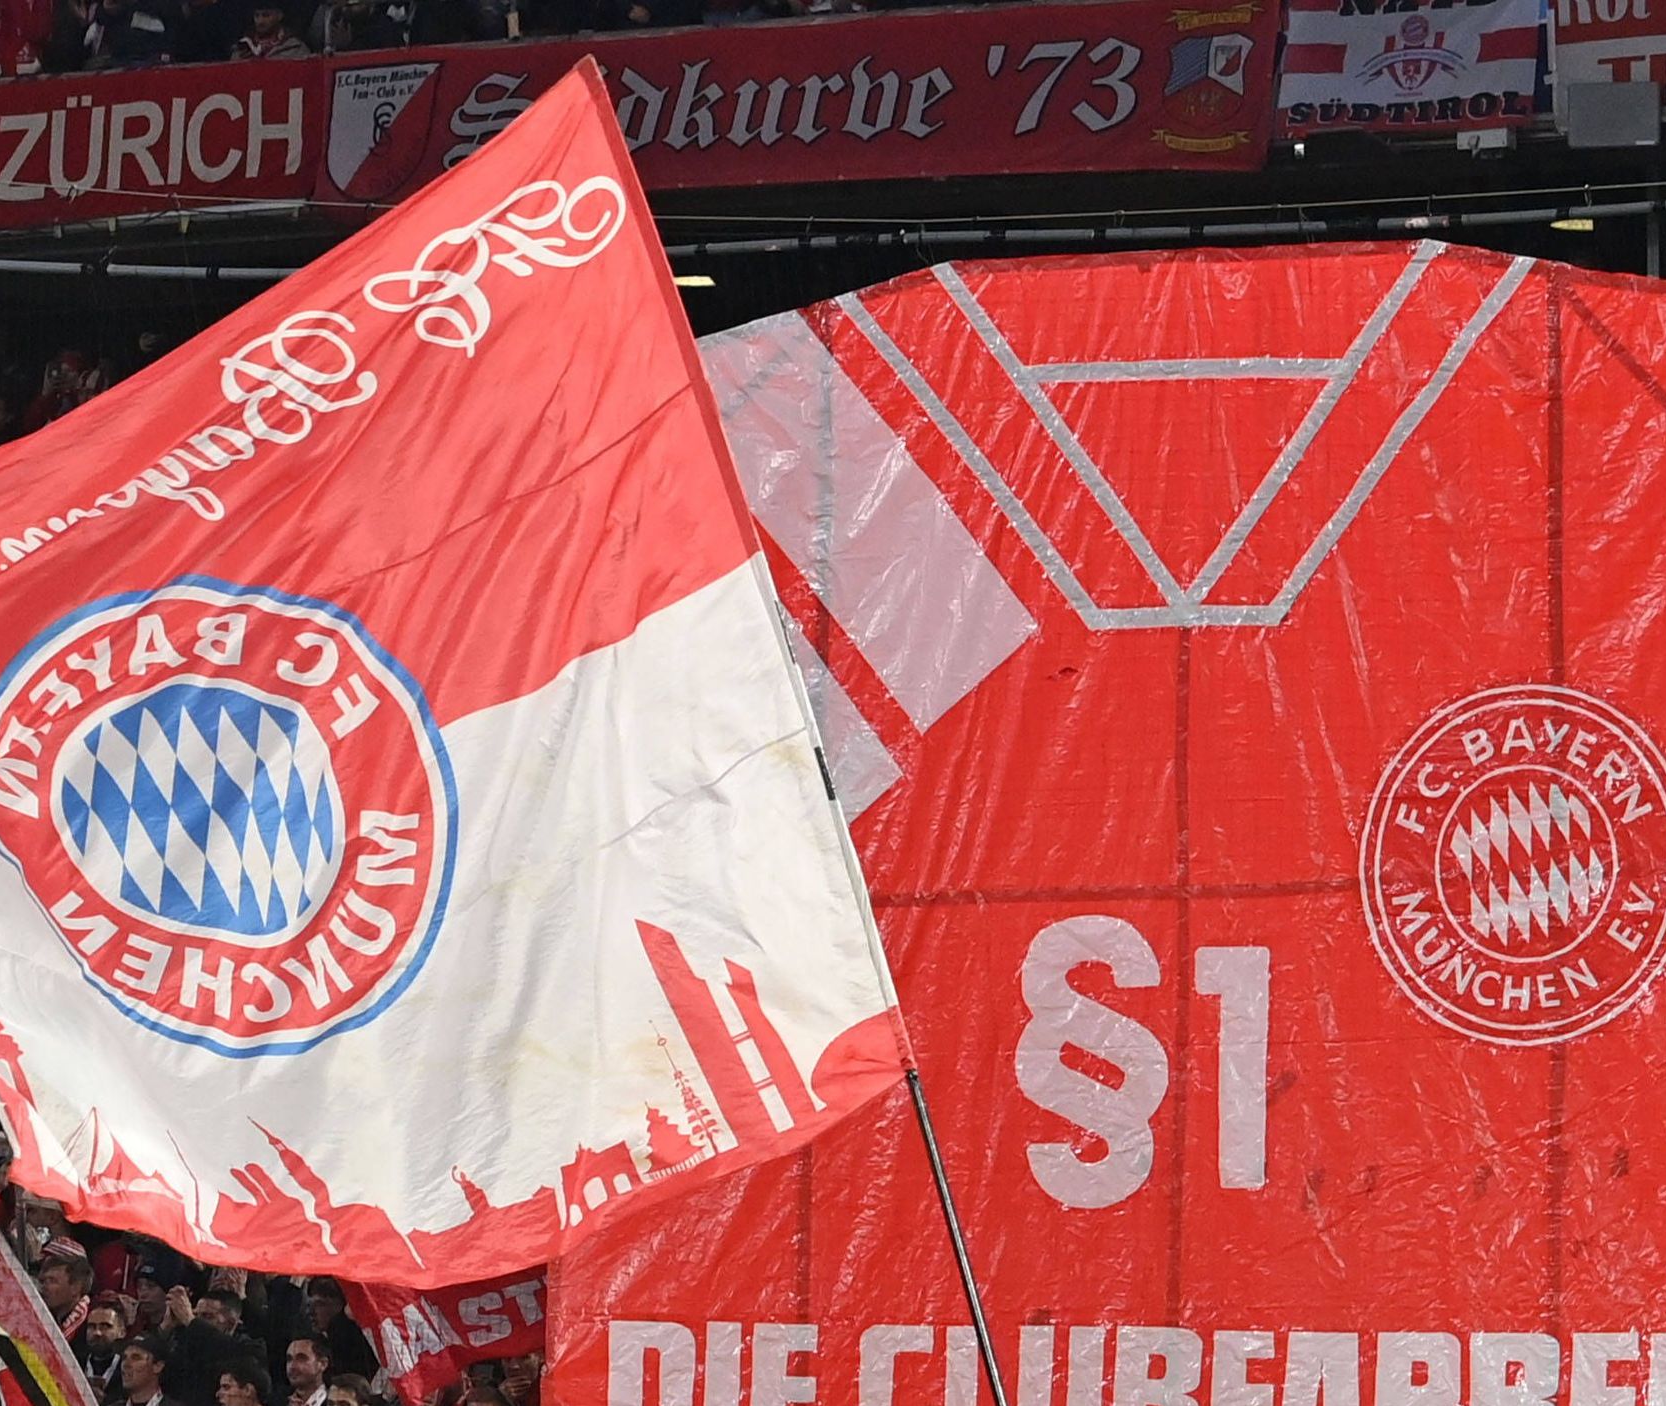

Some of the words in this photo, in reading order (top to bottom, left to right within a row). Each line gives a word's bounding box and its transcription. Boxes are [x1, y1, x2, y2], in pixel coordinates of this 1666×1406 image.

[442, 56, 955, 171] Sdkurve
[1286, 91, 1527, 127] SÜDTIROL
[1460, 716, 1653, 824] BAYERN
[1391, 891, 1598, 1012] MÜNCHEN
